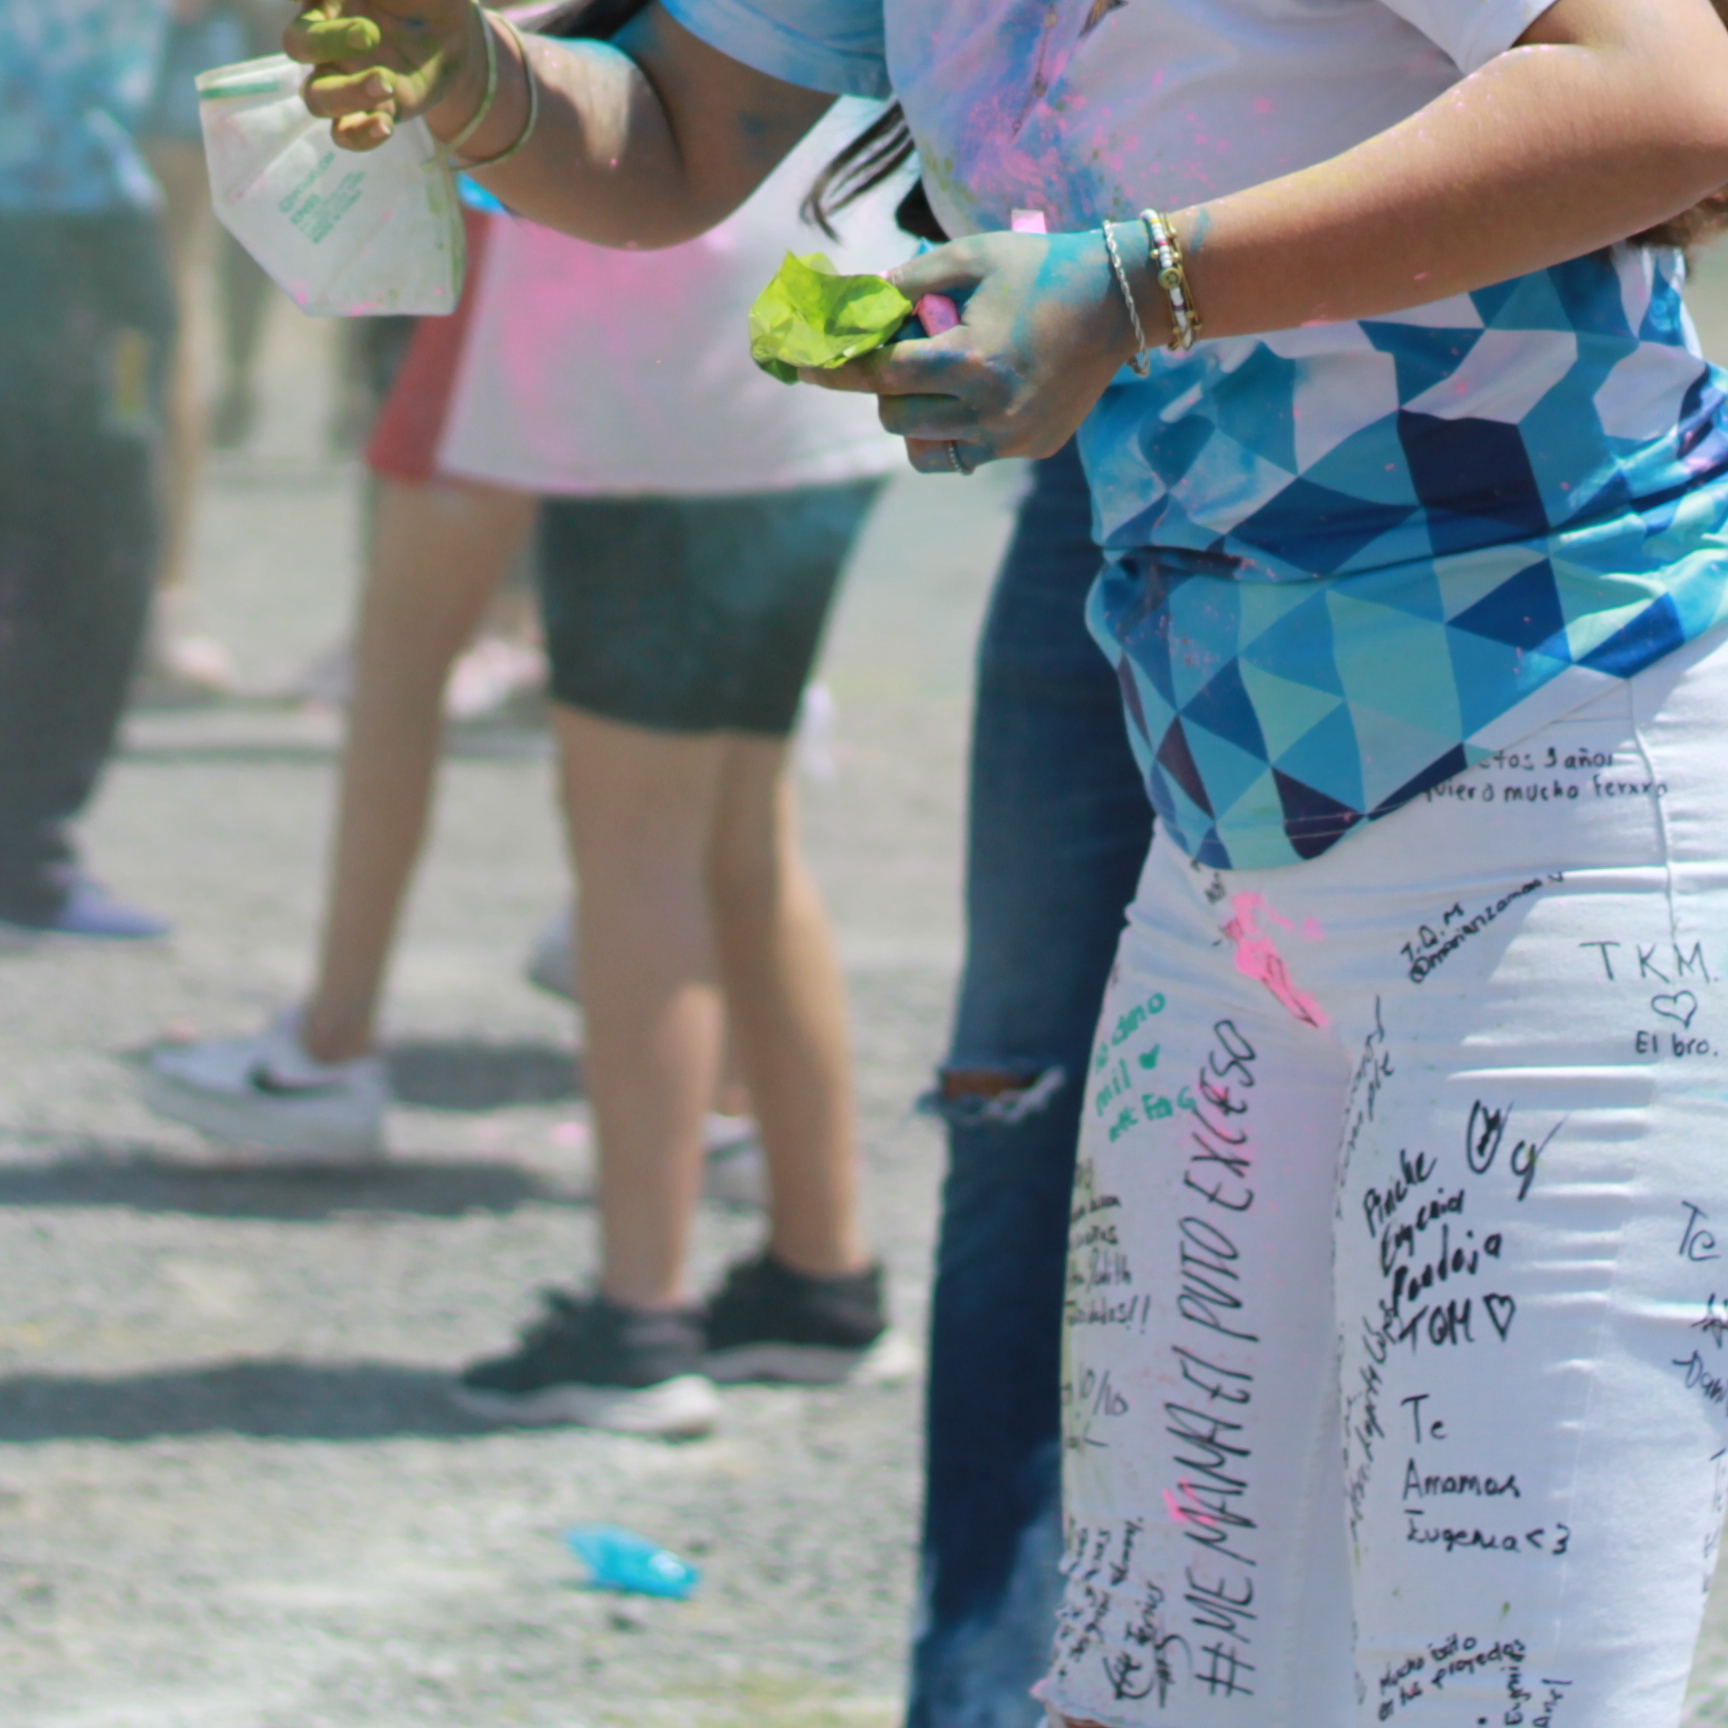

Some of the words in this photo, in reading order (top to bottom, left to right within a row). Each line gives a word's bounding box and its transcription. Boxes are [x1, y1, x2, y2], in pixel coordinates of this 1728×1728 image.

[1503, 779, 1579, 803] mucho
[1183, 1019, 1257, 1212] EXCESO
[1177, 1215, 1260, 1342] PUTO
[1400, 1393, 1447, 1445] Te
